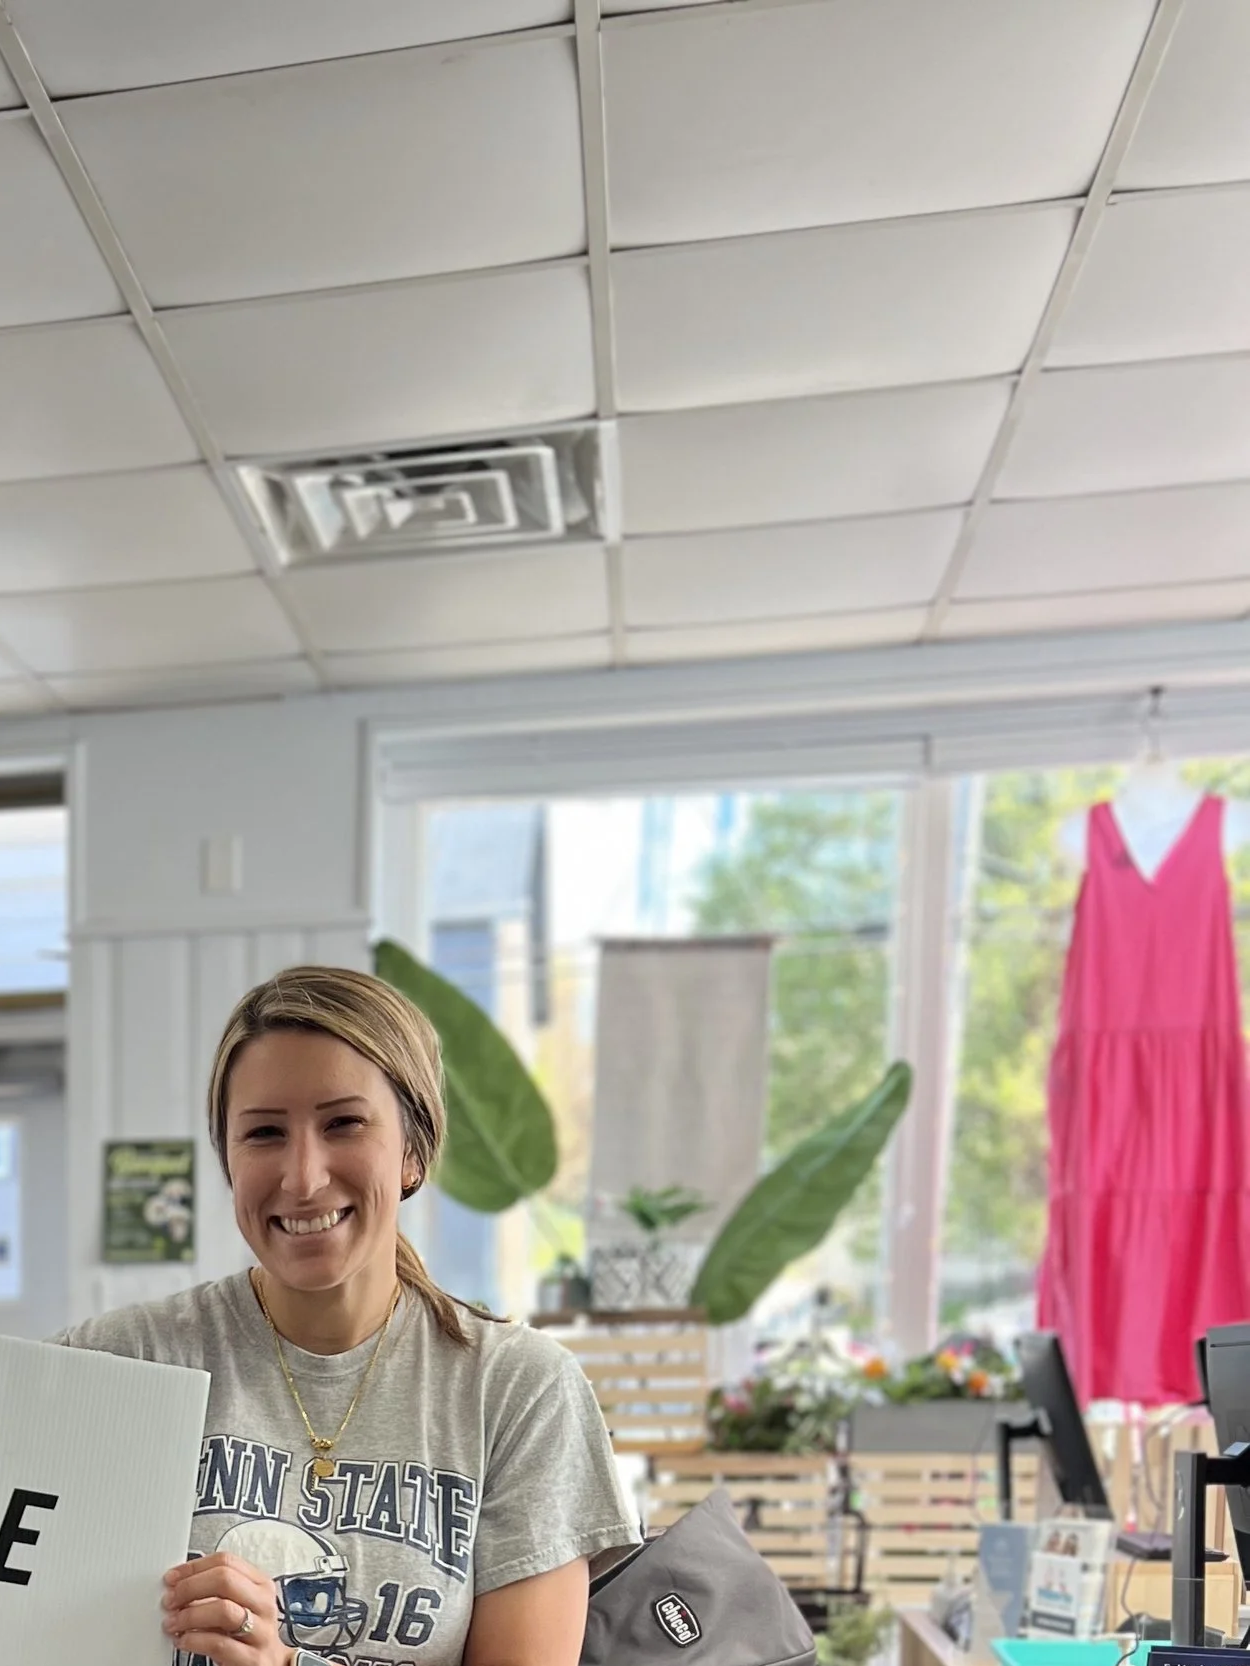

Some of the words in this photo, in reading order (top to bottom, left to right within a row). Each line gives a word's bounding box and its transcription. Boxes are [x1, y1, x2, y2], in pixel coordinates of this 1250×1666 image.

[192, 1433, 293, 1519] NN
[298, 1458, 479, 1582] STATE
[368, 1578, 443, 1648] 16
[661, 1601, 691, 1641] chicco
